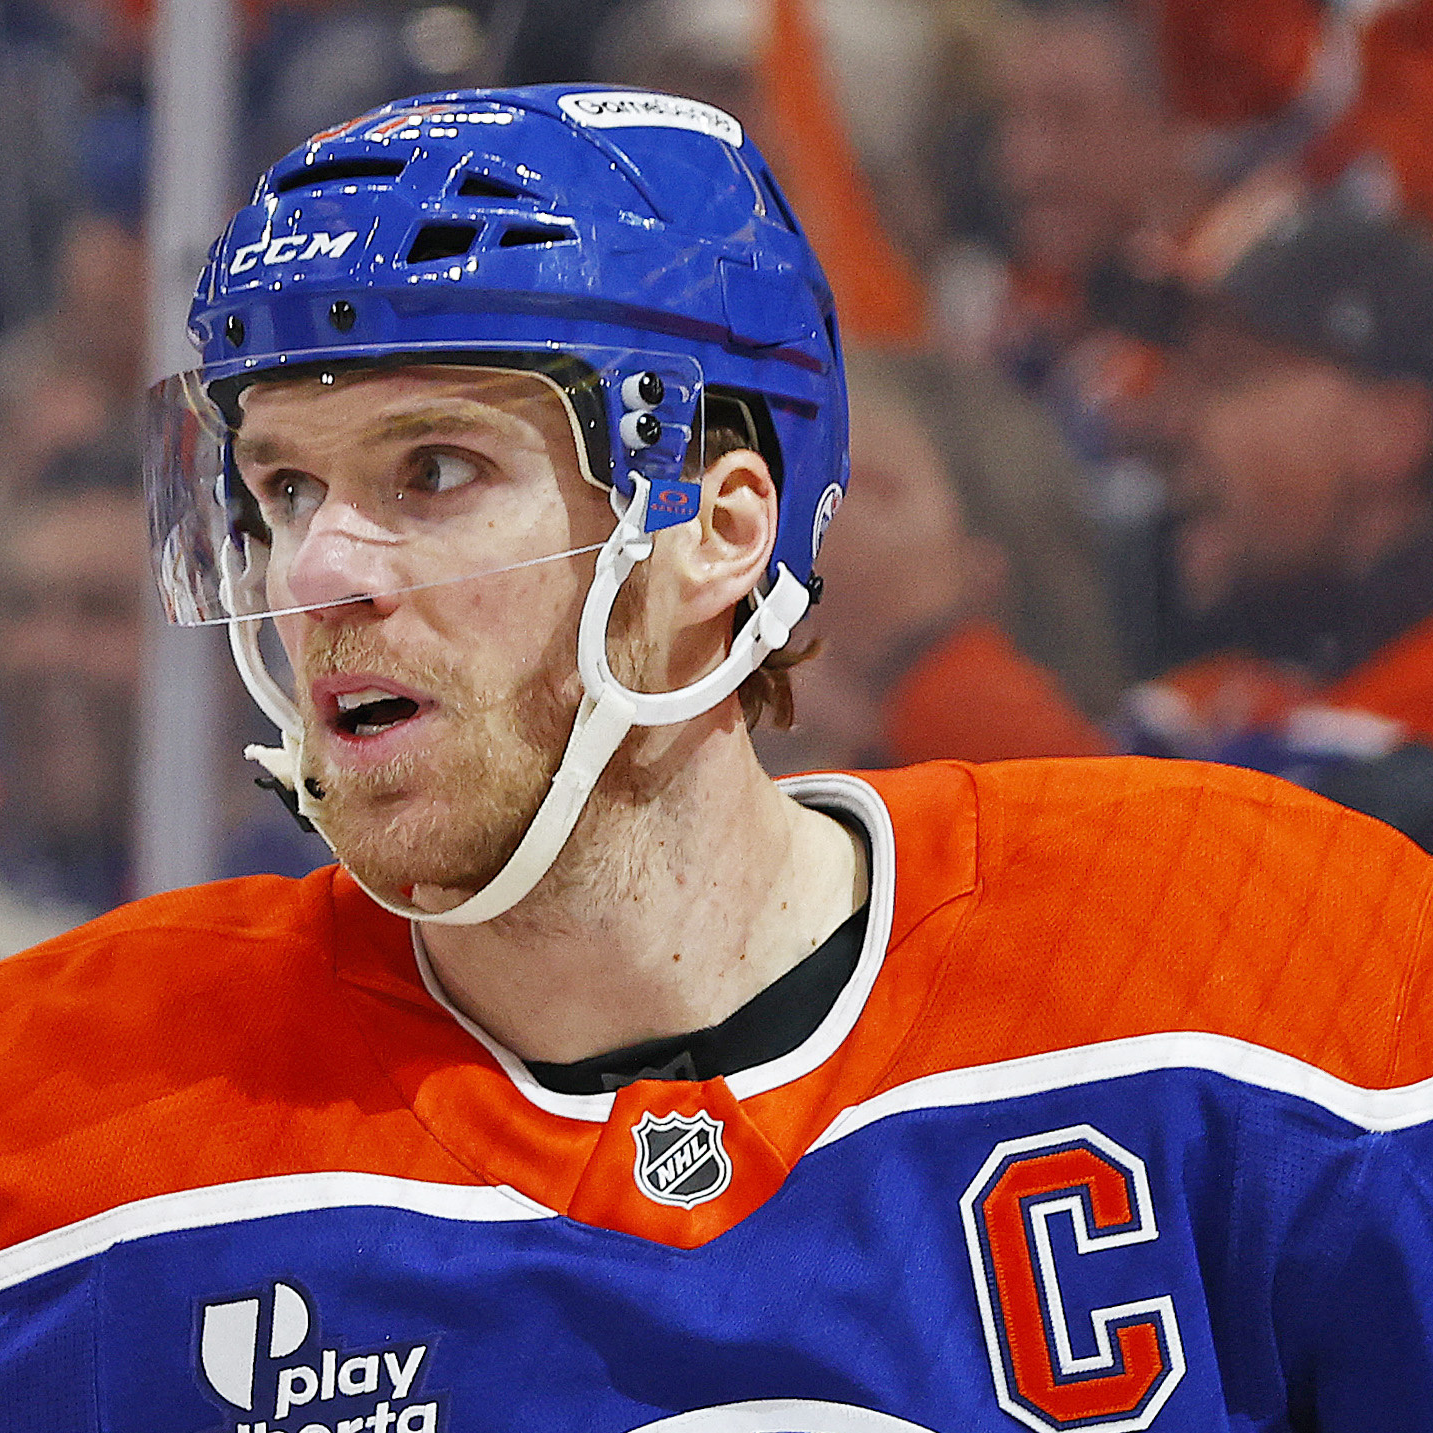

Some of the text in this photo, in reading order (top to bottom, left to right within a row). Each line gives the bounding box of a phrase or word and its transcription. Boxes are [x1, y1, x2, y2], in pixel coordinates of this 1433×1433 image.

[229, 231, 358, 275] CCM
[656, 1135, 708, 1190] NHL
[274, 1346, 425, 1420] play
